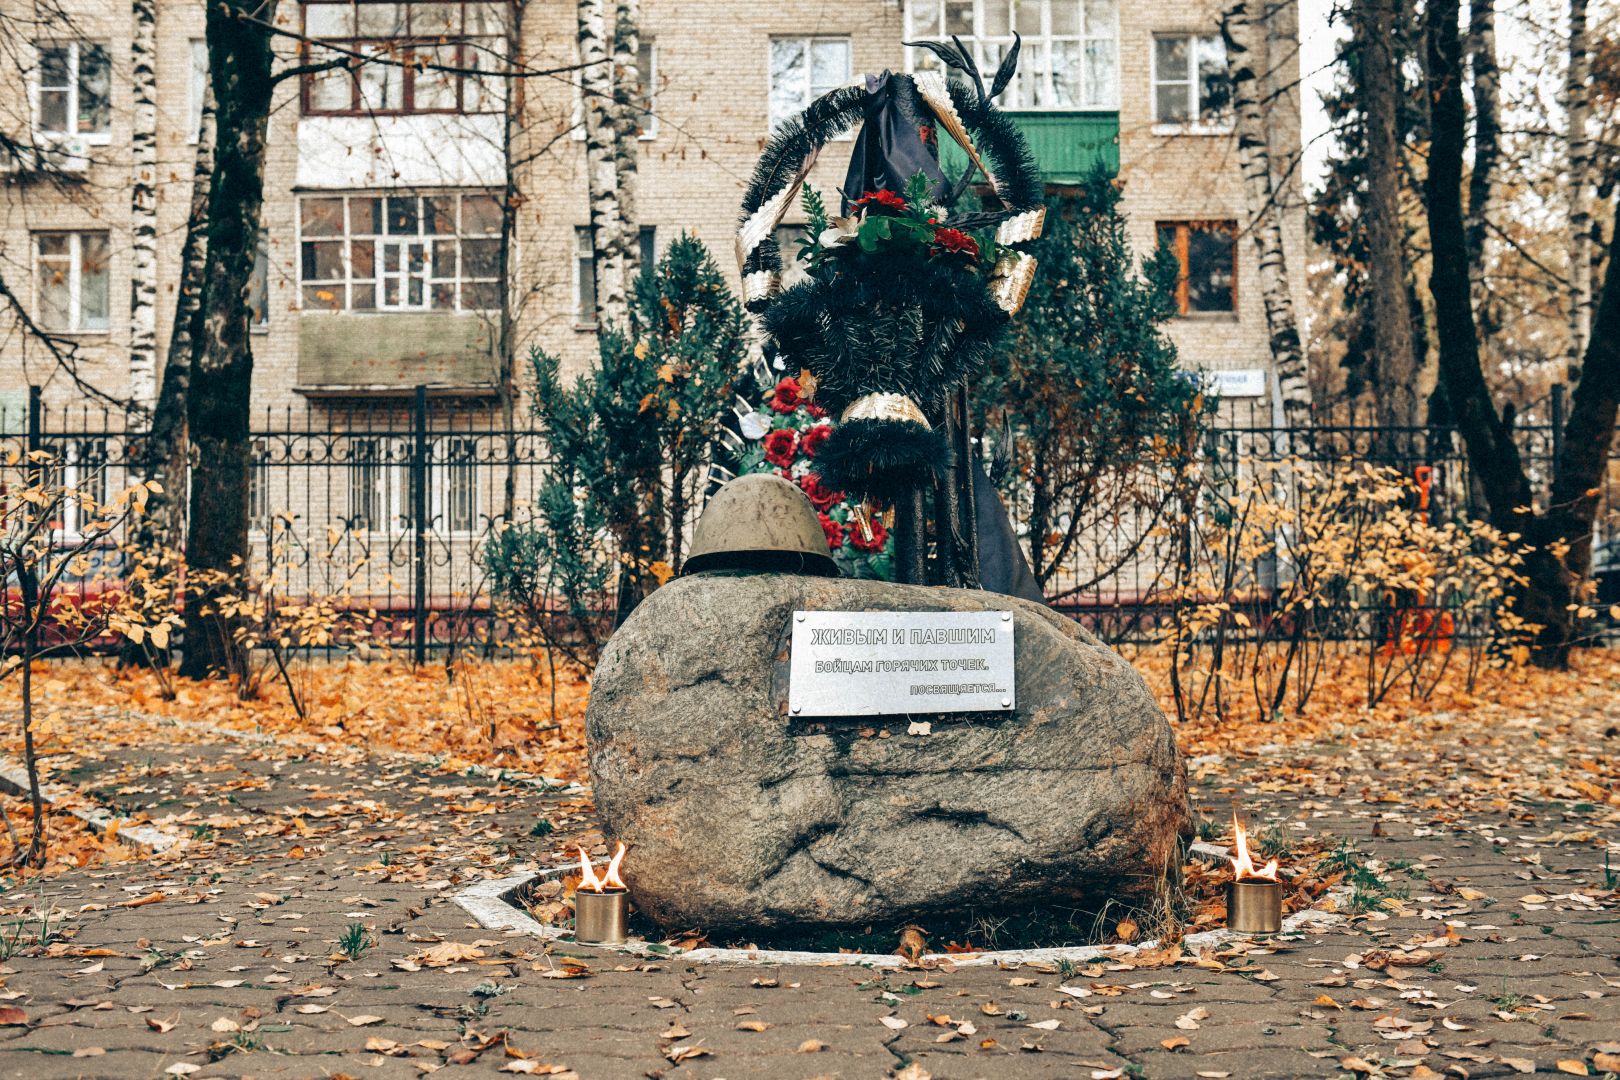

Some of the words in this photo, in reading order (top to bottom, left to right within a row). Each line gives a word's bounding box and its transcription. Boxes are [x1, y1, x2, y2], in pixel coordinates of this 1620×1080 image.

[810, 628, 888, 645] ЖИВЫМ
[892, 628, 905, 645] И
[909, 628, 996, 645] ПАВШИМ
[815, 658, 873, 675] БОЙЦАМ
[875, 659, 938, 673] ГОРЯЧИХ
[941, 658, 989, 671] ТОЧЕК.
